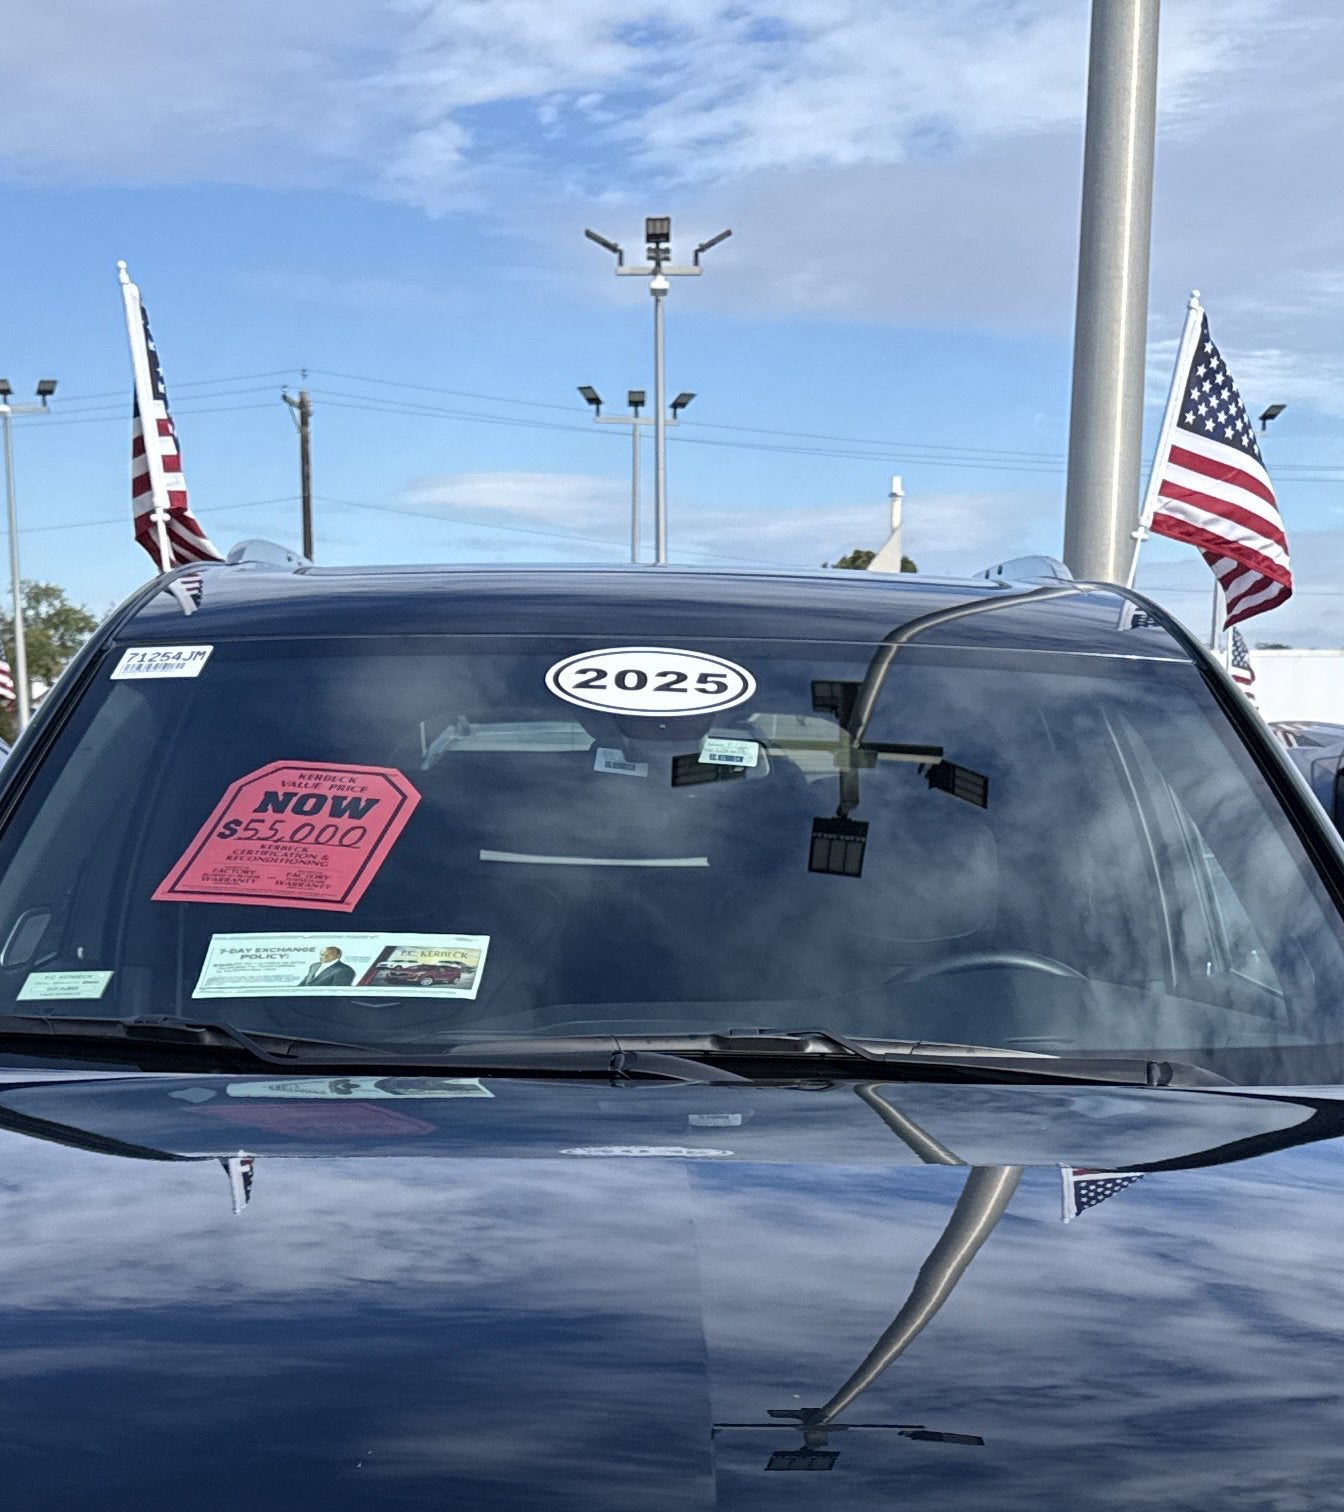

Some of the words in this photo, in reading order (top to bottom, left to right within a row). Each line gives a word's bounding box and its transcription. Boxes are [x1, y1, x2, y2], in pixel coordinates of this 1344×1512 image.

[127, 651, 207, 663] 71254JM
[572, 667, 728, 695] 2025
[281, 780, 322, 790] VALUE
[328, 783, 368, 793] PRICE
[253, 790, 381, 820] NOW
[216, 819, 367, 847] $55,000
[232, 848, 318, 860] CERTIFICATION
[225, 855, 329, 867] RECONDITIONING
